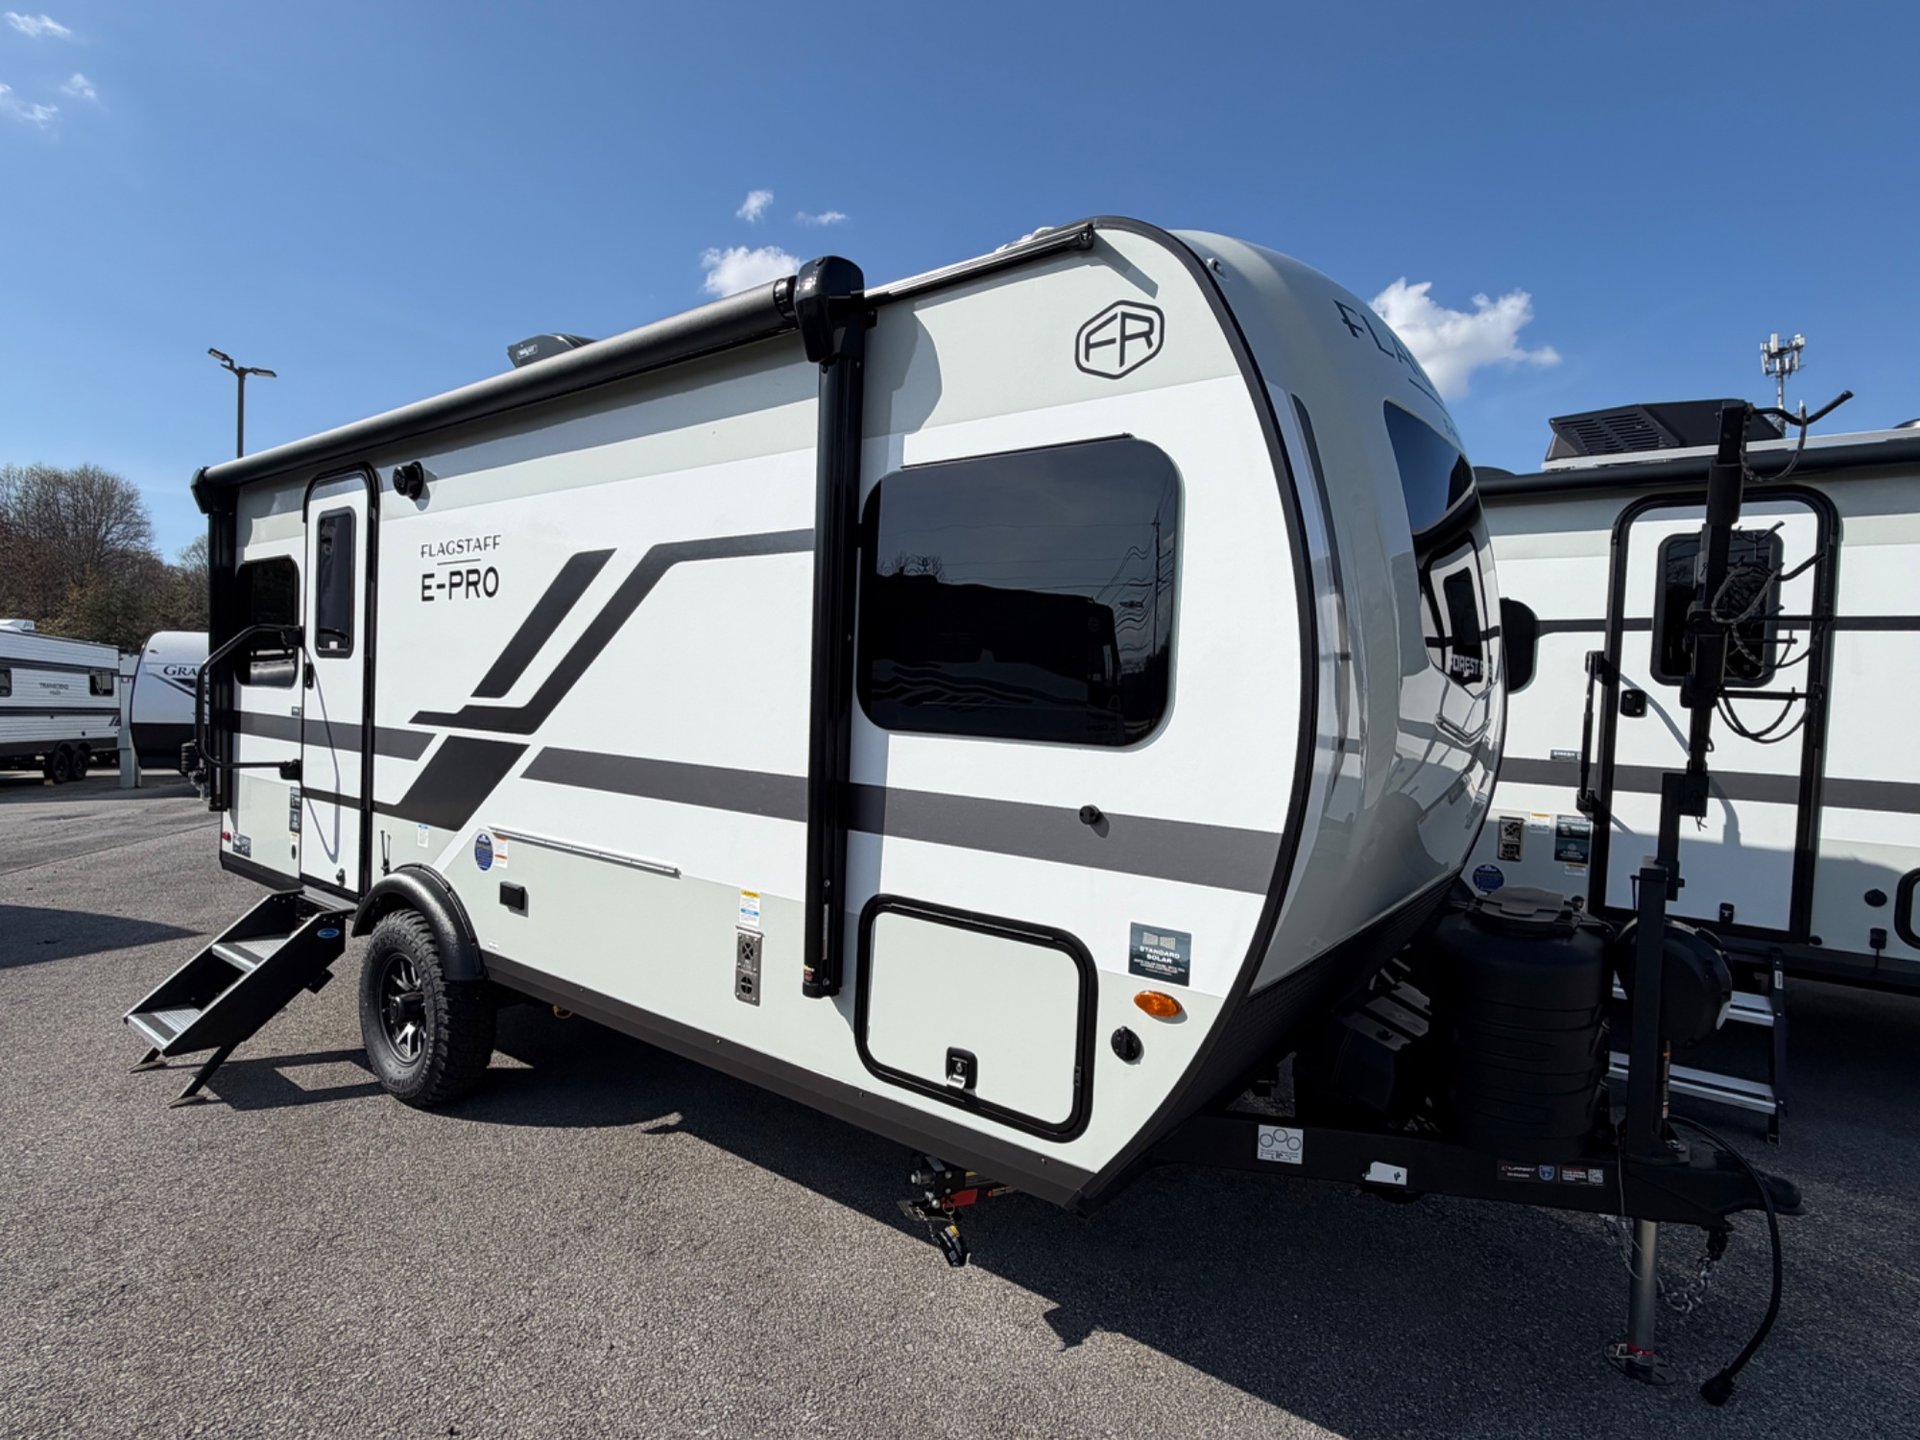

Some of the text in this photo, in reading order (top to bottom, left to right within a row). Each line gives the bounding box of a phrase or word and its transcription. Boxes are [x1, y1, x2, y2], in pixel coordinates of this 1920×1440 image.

[421, 535, 502, 558] FLAGSTAFF
[421, 566, 499, 602] E-PRO
[163, 664, 208, 676] GRA
[1139, 946, 1180, 958] STANDARD
[1146, 954, 1172, 963] SOLAR
